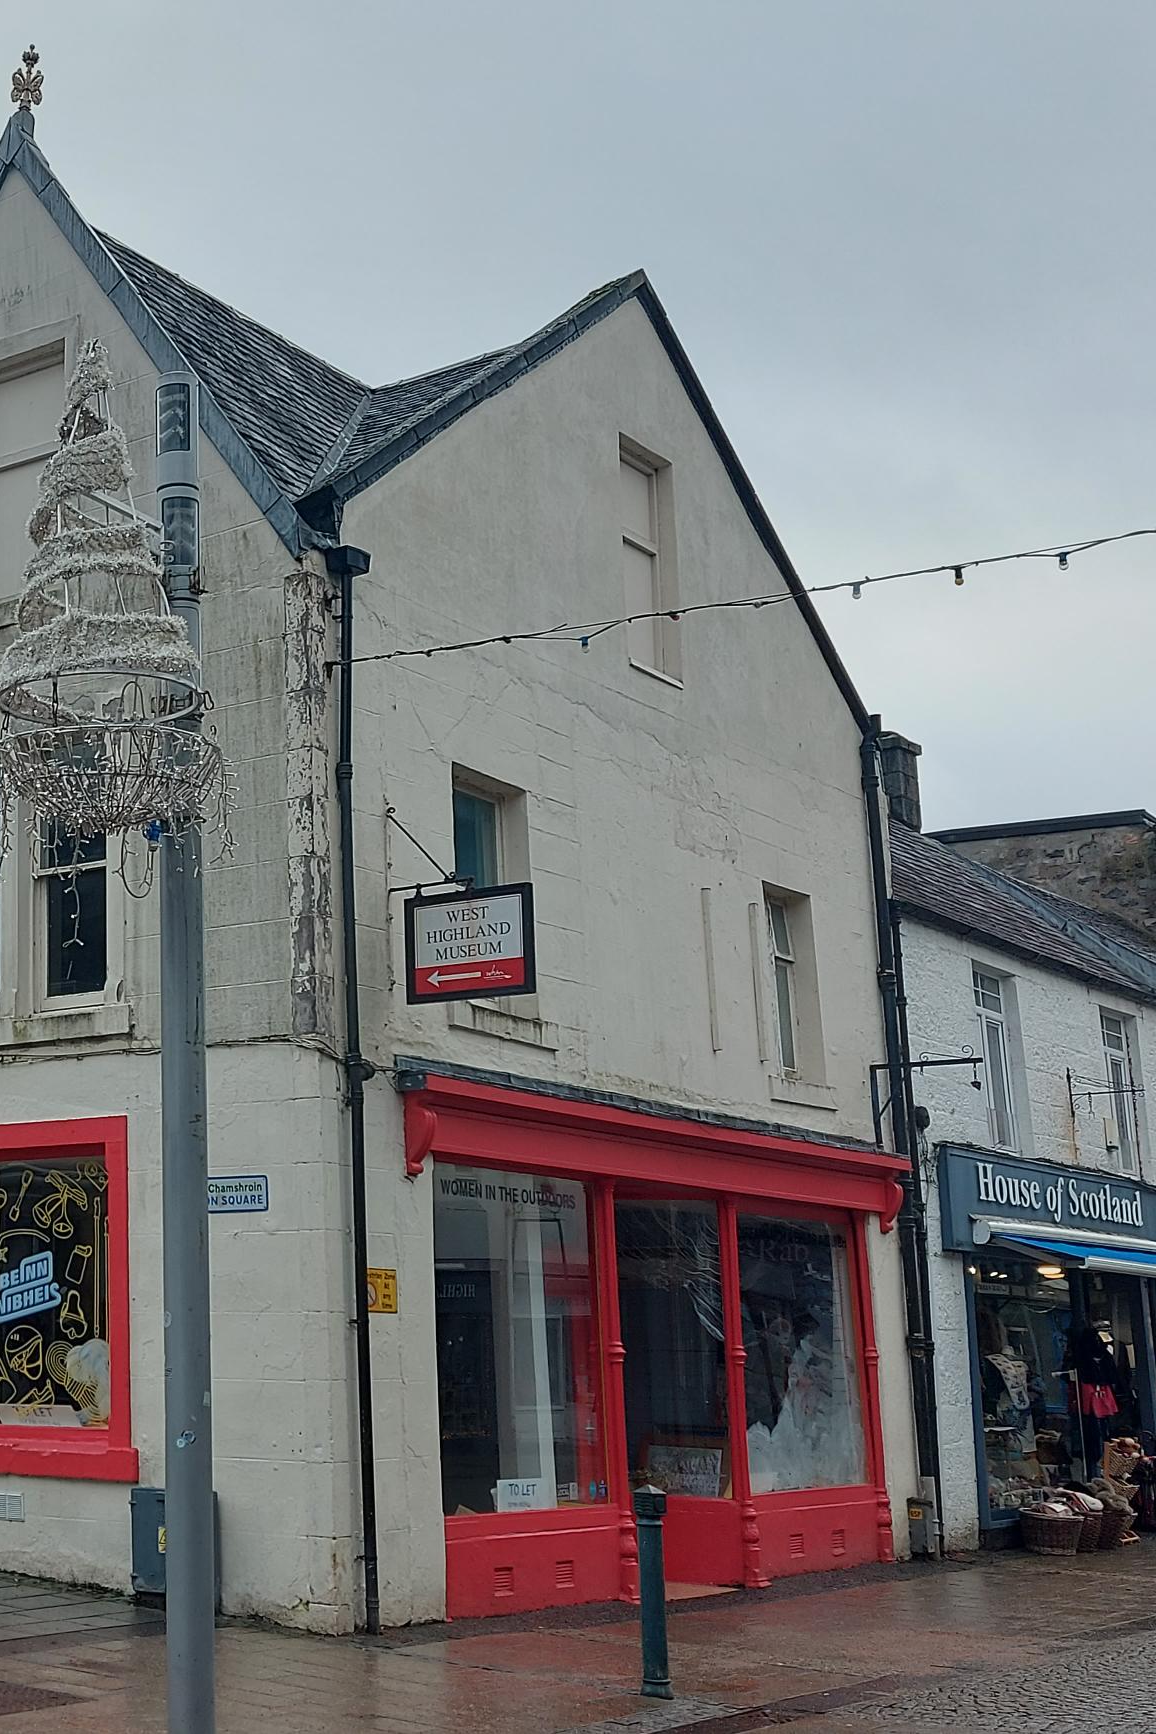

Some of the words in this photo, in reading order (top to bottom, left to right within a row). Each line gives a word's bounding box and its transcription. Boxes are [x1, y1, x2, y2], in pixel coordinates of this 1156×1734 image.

[446, 906, 489, 923] WEST
[426, 922, 511, 944] HIGHLAND
[435, 941, 502, 961] MUSEUM
[208, 1182, 262, 1193] Chamshroin
[440, 1178, 482, 1199] WOMEN
[485, 1185, 496, 1201] IN
[498, 1186, 519, 1204] THE
[521, 1189, 576, 1210] OUTDOORS
[976, 1162, 1042, 1210] House
[1046, 1177, 1064, 1223] of
[1068, 1178, 1144, 1227] Scotland
[222, 1195, 263, 1206] SQUARE
[0, 1251, 53, 1291] BEINN
[508, 1483, 519, 1496] TO
[521, 1484, 537, 1496] LET
